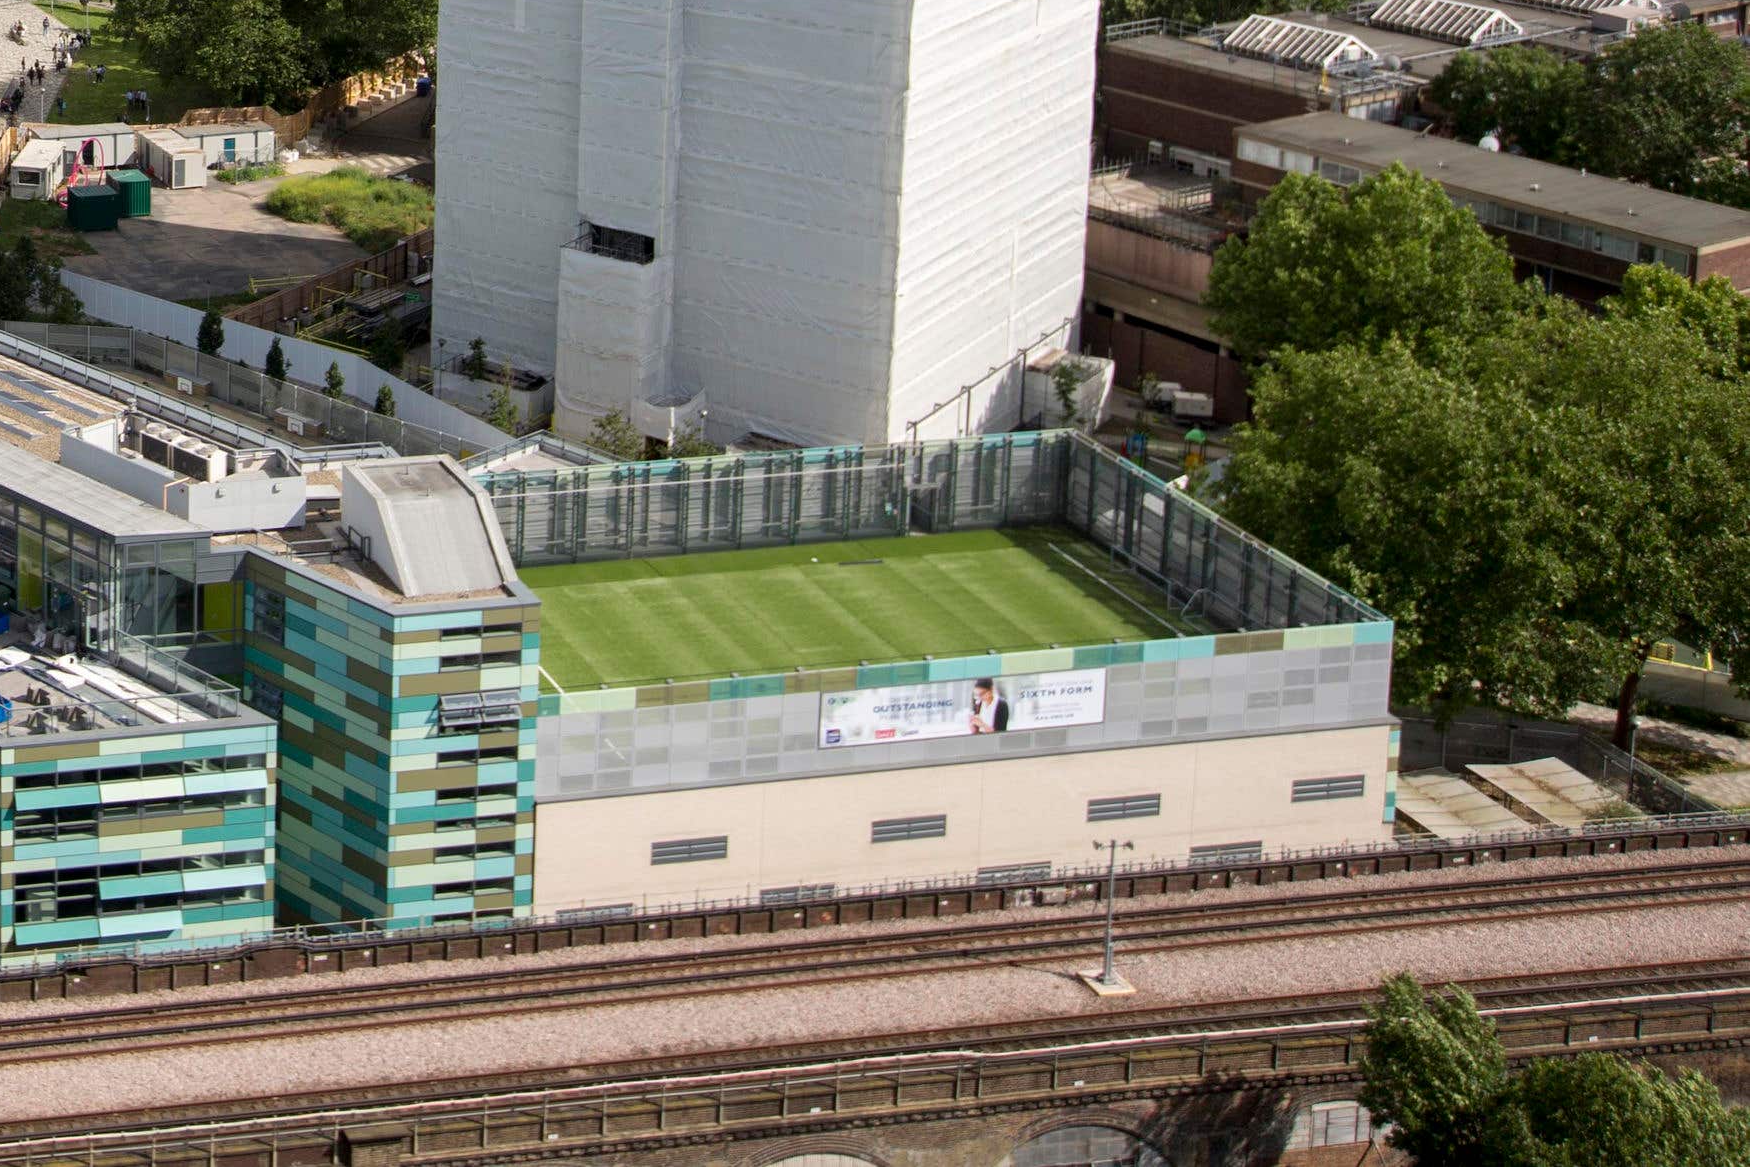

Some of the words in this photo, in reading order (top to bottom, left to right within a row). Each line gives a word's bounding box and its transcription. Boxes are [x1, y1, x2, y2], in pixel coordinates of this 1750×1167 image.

[1019, 689, 1056, 699] SIXTH
[1060, 686, 1093, 696] FORM
[873, 699, 953, 713] OUTSTANDING
